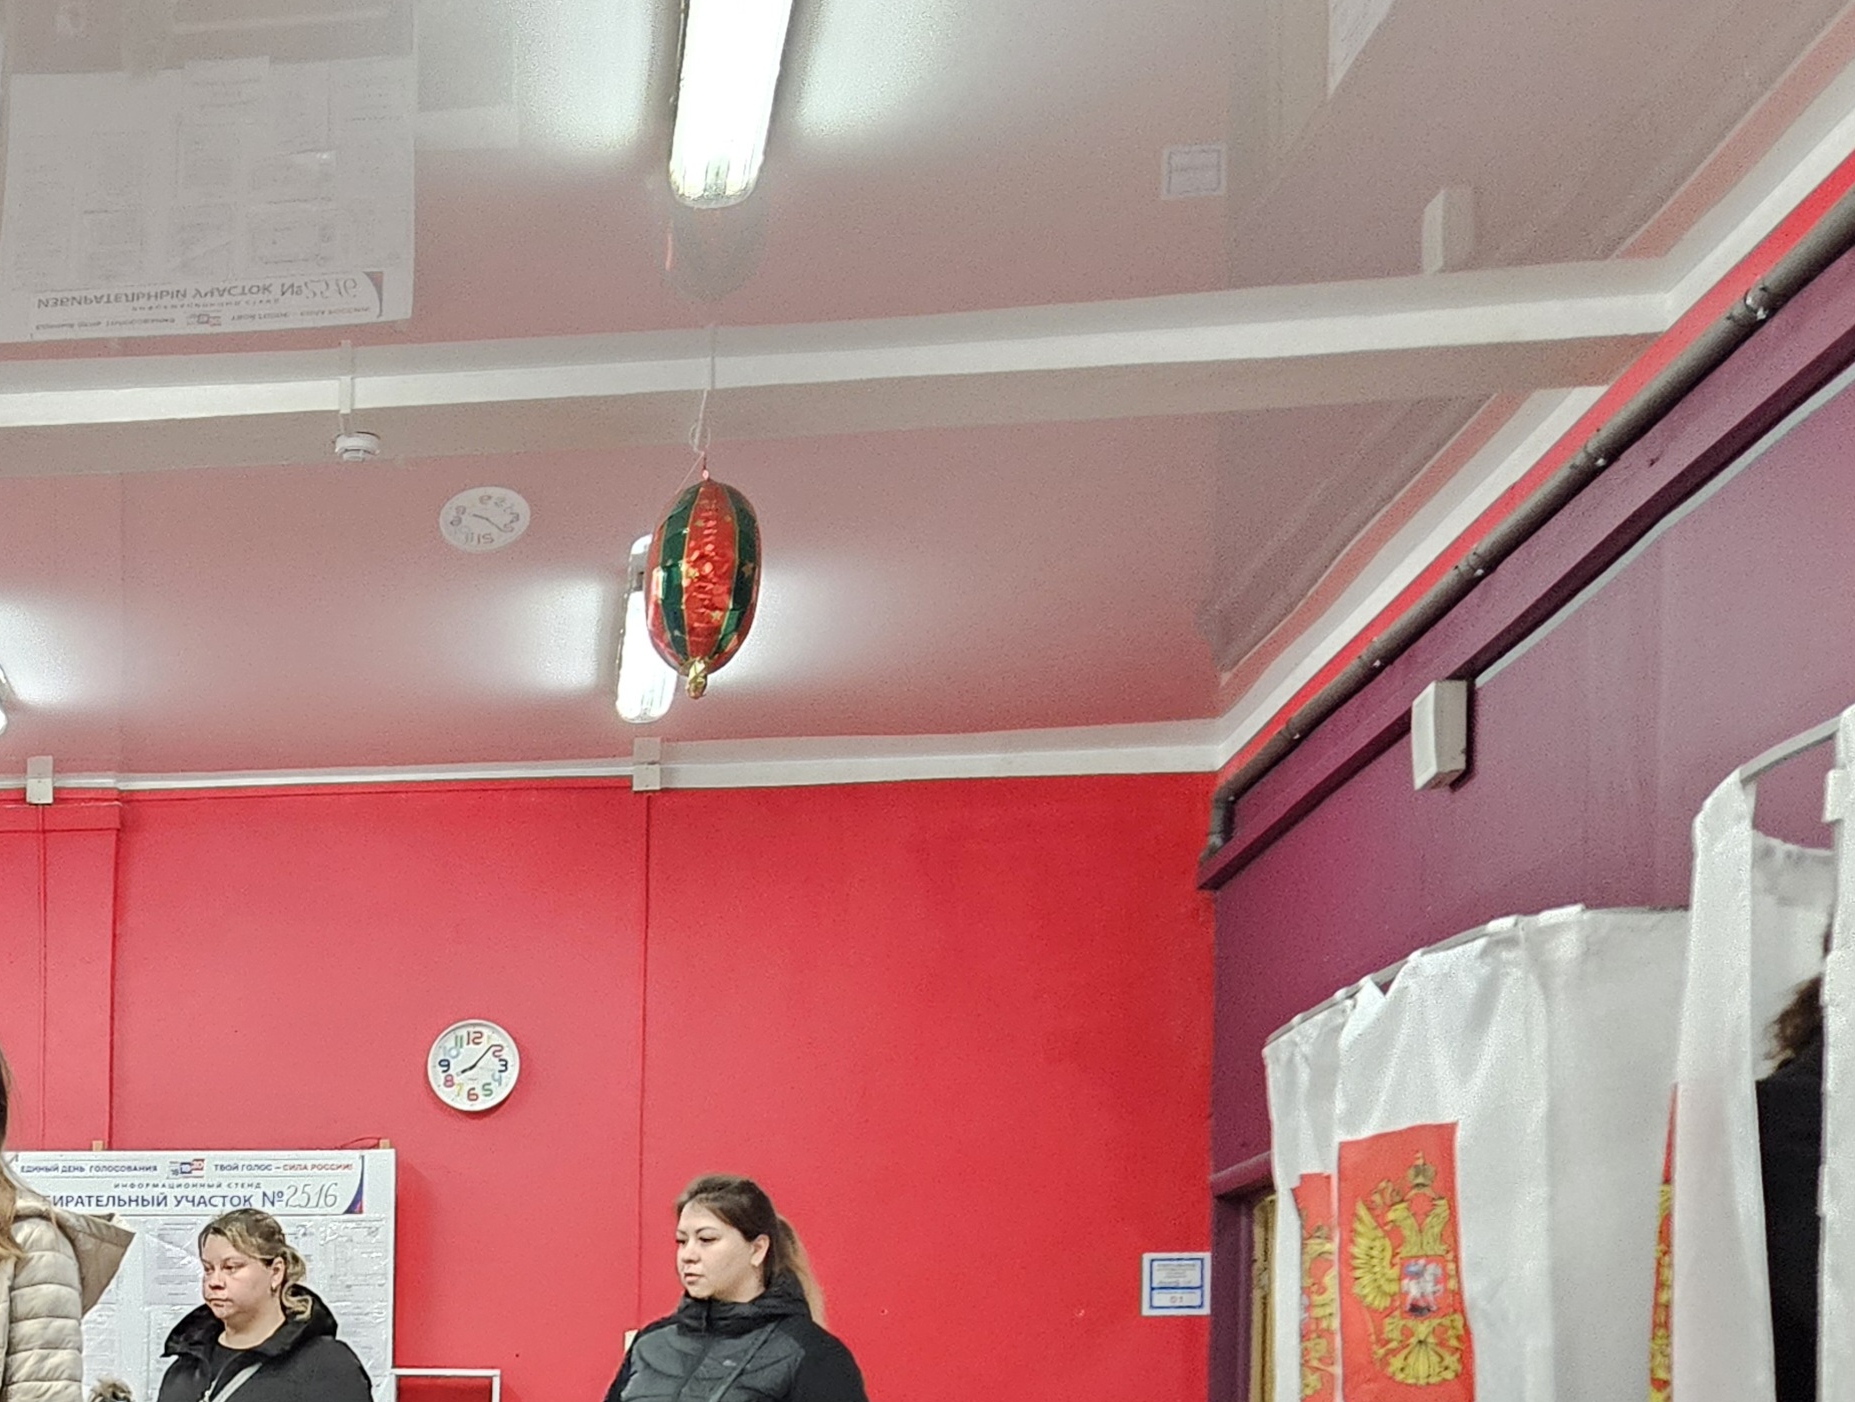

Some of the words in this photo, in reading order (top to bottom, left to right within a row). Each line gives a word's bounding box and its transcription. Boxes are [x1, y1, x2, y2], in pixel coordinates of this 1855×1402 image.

[455, 1035, 464, 1049] 11
[466, 1030, 484, 1046] 12
[442, 1046, 460, 1059] 10
[492, 1044, 504, 1058] 2
[438, 1059, 451, 1073] 9
[498, 1058, 508, 1073] 3
[443, 1074, 455, 1088] 8
[491, 1073, 502, 1086] 4
[467, 1087, 479, 1101] 6
[482, 1082, 493, 1097] 5
[20, 1164, 58, 1173] ЕДИНЫЙ
[61, 1165, 85, 1174] ДЕНЬ
[89, 1165, 157, 1173] ГОЛОСОВАНИЯ
[214, 1163, 238, 1172] ТВОЙ
[241, 1164, 272, 1172] ГОЛОС
[227, 1182, 262, 1190] СТЕНД
[46, 1192, 167, 1208] ИРАТЕЛЬНЫЙ
[174, 1195, 252, 1208] УЧАСТОК
